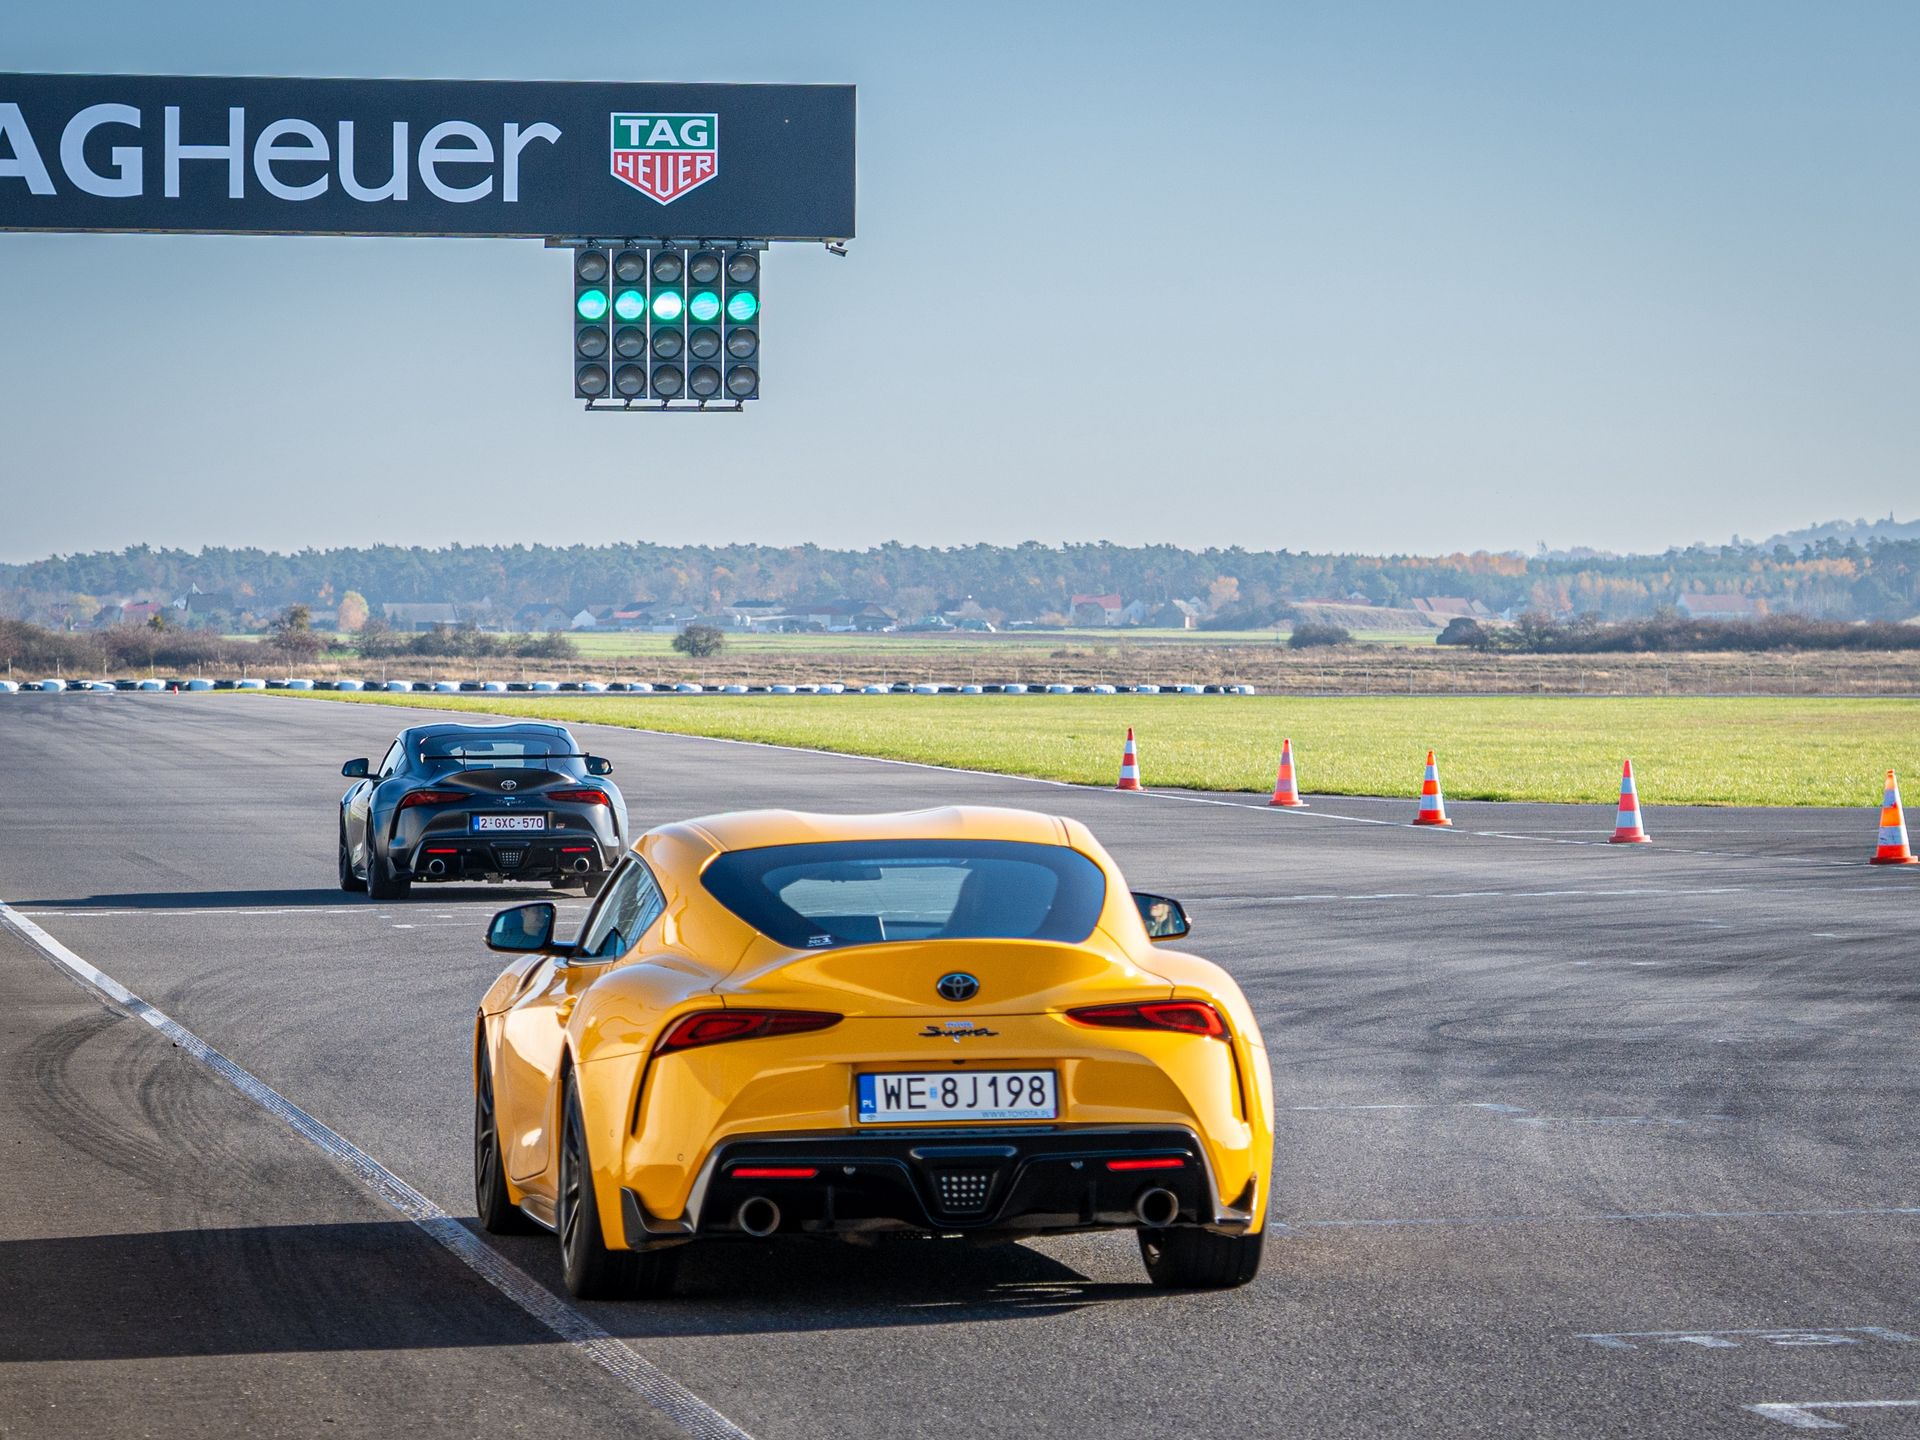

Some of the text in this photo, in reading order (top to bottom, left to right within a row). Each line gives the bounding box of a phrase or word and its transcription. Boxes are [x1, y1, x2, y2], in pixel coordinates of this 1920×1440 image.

[620, 119, 708, 147] TAG
[617, 155, 712, 198] HEUER
[862, 1099, 875, 1109] PL
[882, 1075, 1047, 1110] WE 8J198
